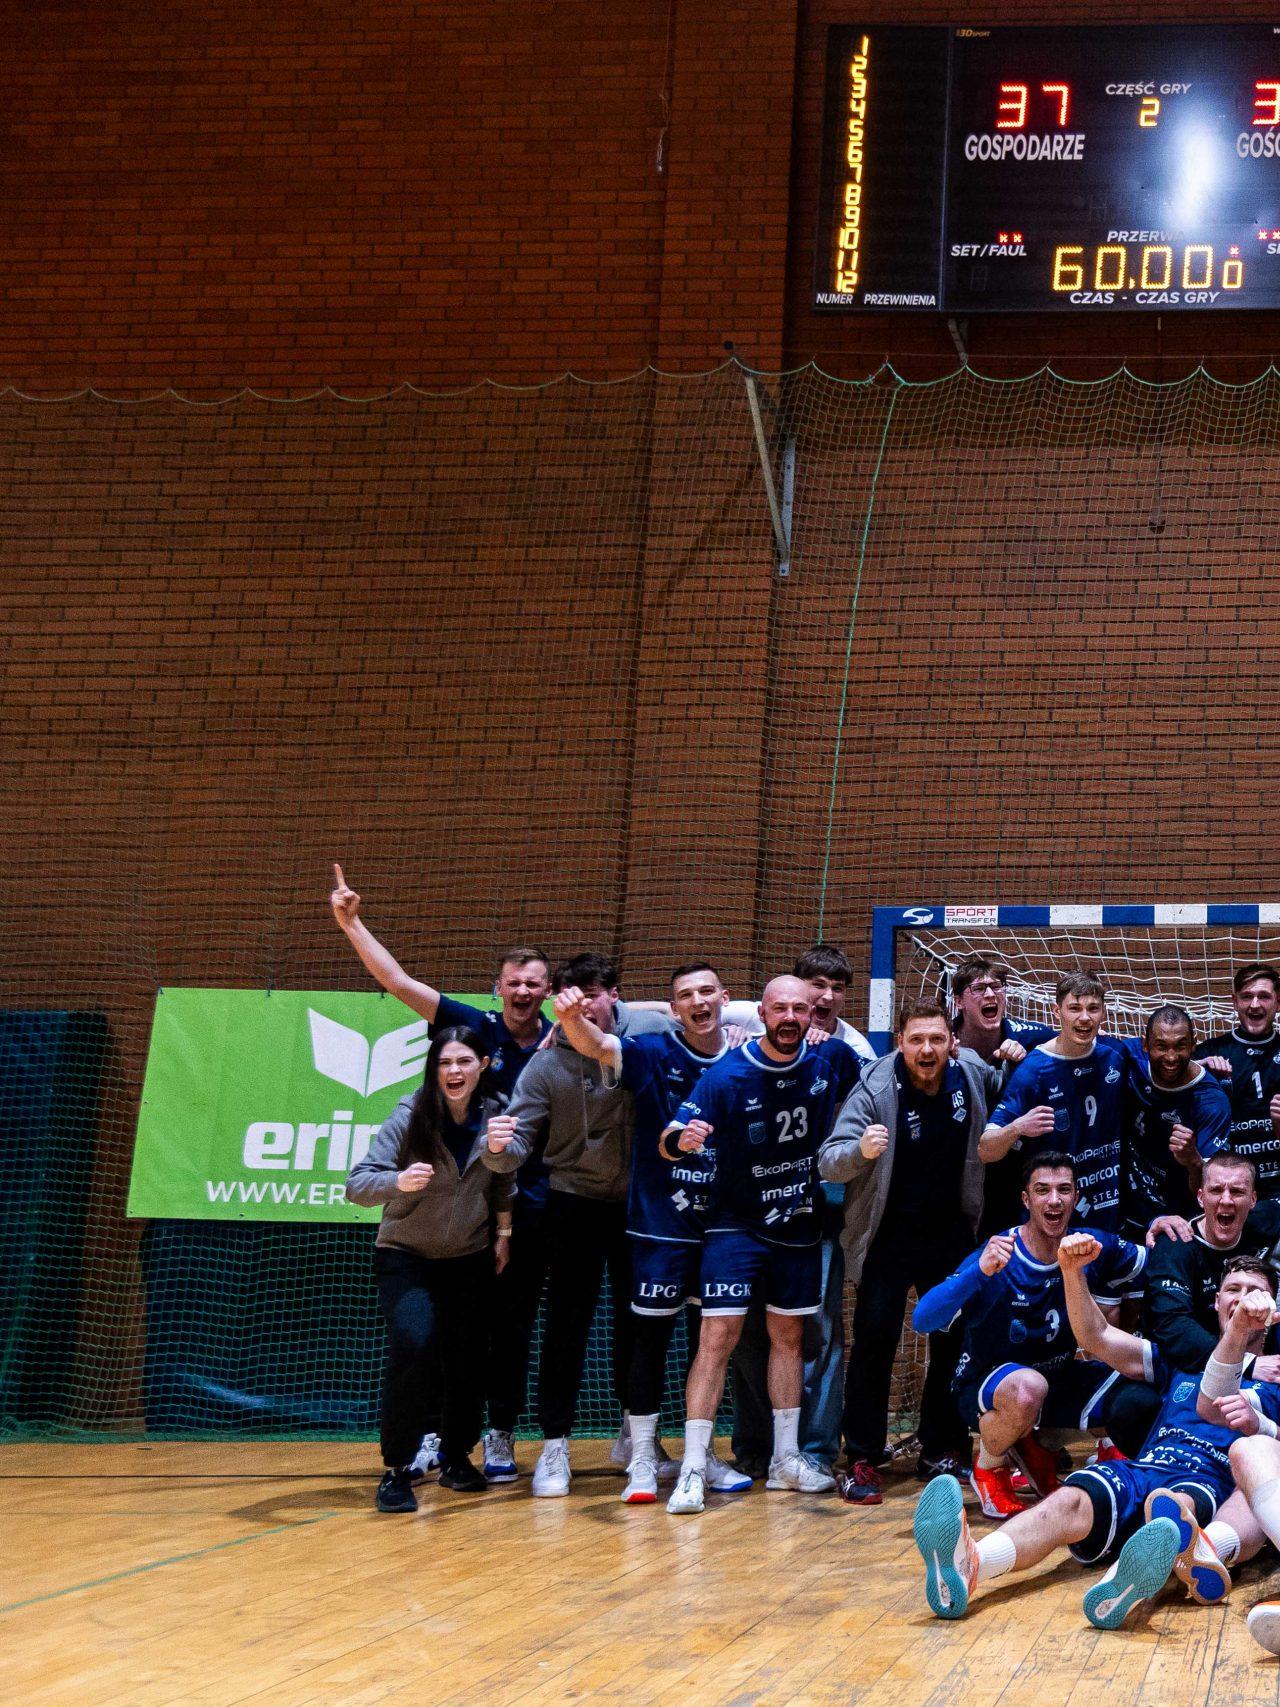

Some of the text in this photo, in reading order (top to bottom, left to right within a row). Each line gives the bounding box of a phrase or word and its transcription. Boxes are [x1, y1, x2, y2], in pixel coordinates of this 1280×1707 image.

[862, 34, 869, 56] 1
[851, 55, 868, 78] 2
[851, 77, 867, 99] 3
[1105, 80, 1192, 97] CZĘŚĆ GRY
[850, 99, 866, 119] 4
[996, 83, 1070, 129] 37
[1139, 97, 1160, 127] 2
[849, 119, 864, 141] 5
[847, 141, 863, 163] 6
[965, 134, 1086, 161] GOSPODARZE
[849, 164, 862, 183] 7
[845, 184, 861, 206] 8
[845, 205, 860, 228] 9
[839, 228, 859, 250] 10
[837, 249, 858, 271] 11
[836, 271, 858, 293] 12
[816, 292, 937, 307] NUMER PRZEWINIENIA
[1070, 292, 1114, 304] CZAS
[1135, 292, 1180, 304] CZAS
[1184, 292, 1221, 303] GRY
[946, 907, 997, 916] SPORT
[1251, 1071, 1264, 1098] 1
[951, 1090, 965, 1109] AS
[1085, 1095, 1098, 1127] 9
[775, 1106, 808, 1143] 23
[206, 1180, 353, 1206] WWW.ER
[1045, 1309, 1060, 1343] 3
